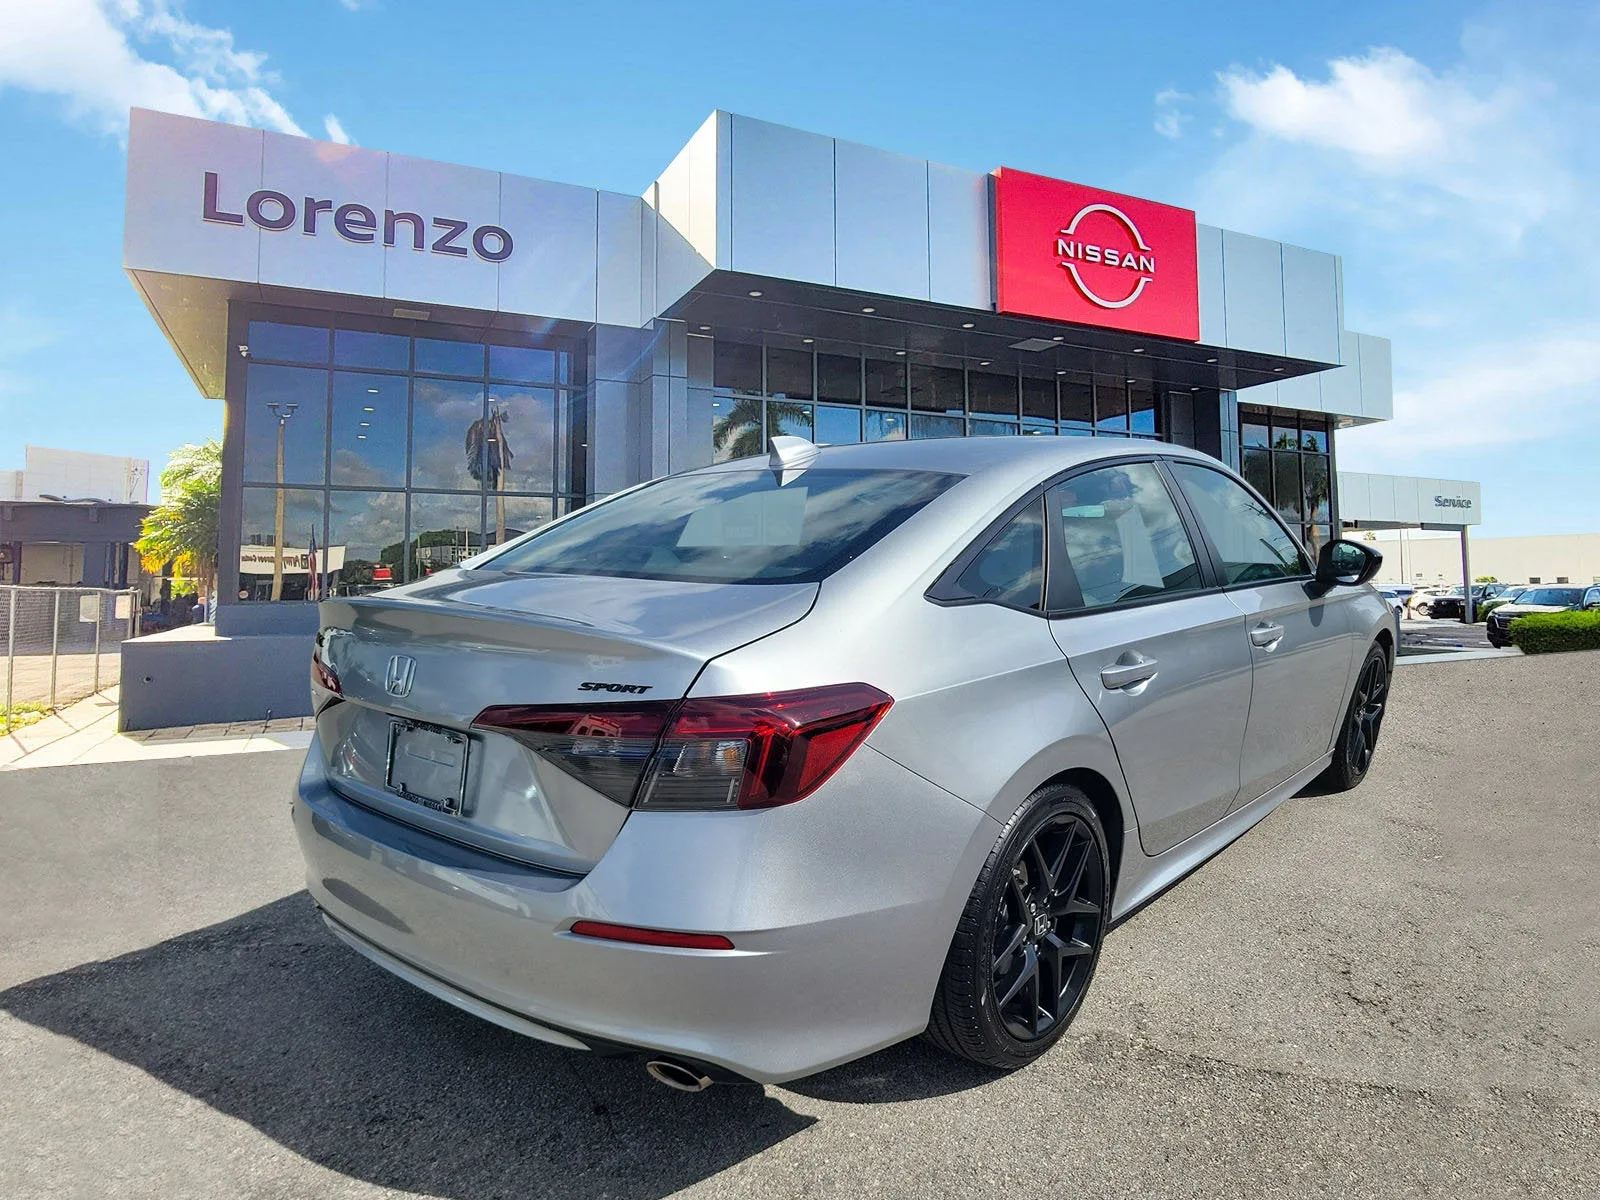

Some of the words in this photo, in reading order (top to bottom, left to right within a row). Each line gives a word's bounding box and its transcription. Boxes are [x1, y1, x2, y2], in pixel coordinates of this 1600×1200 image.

[202, 171, 514, 262] Lorenzo
[1057, 238, 1155, 273] NISSAN
[1434, 495, 1472, 509] Service
[577, 682, 653, 695] SPORT
